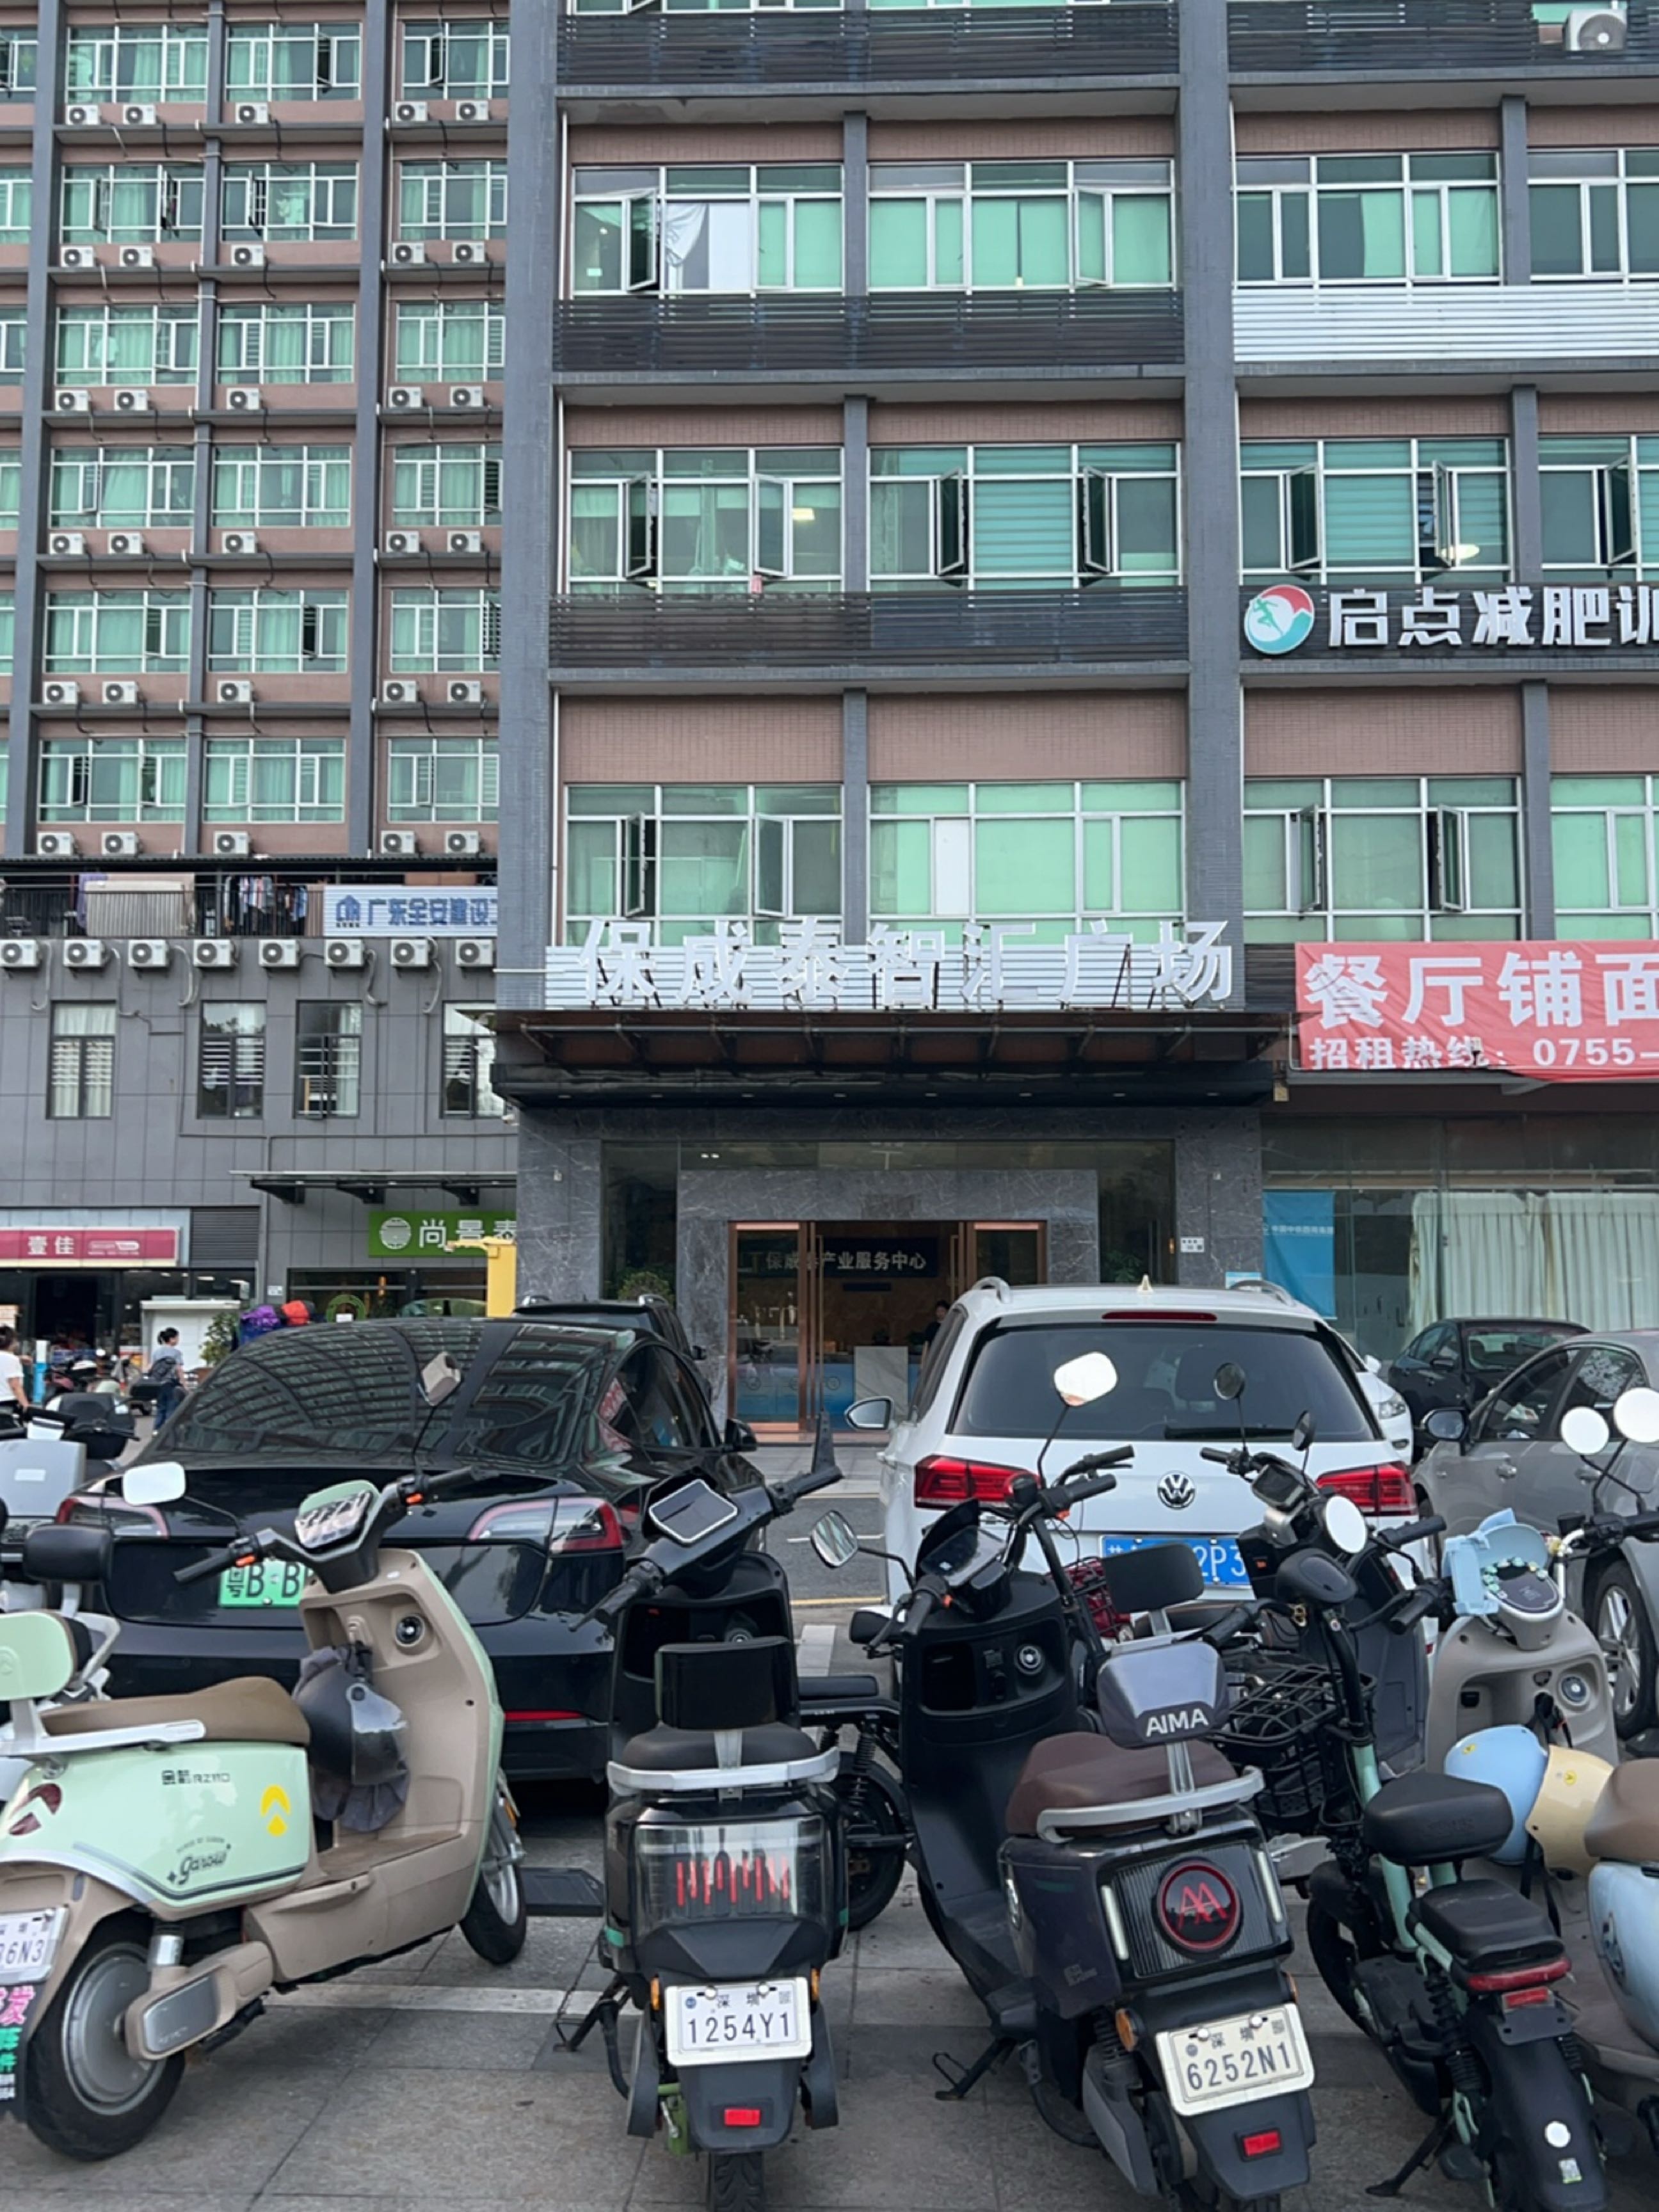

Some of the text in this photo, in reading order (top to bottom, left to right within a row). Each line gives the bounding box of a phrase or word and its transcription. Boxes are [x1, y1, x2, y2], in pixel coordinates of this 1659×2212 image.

[1327, 586, 1659, 646] 启点减肥训
[577, 918, 1233, 1007] 保成泰智汇广场
[1303, 951, 1659, 1029] 餐厅铺面
[1146, 1708, 1209, 1737] AIMA
[687, 2012, 789, 2044] 1254Y1
[1187, 2042, 1290, 2090] 6252N1
